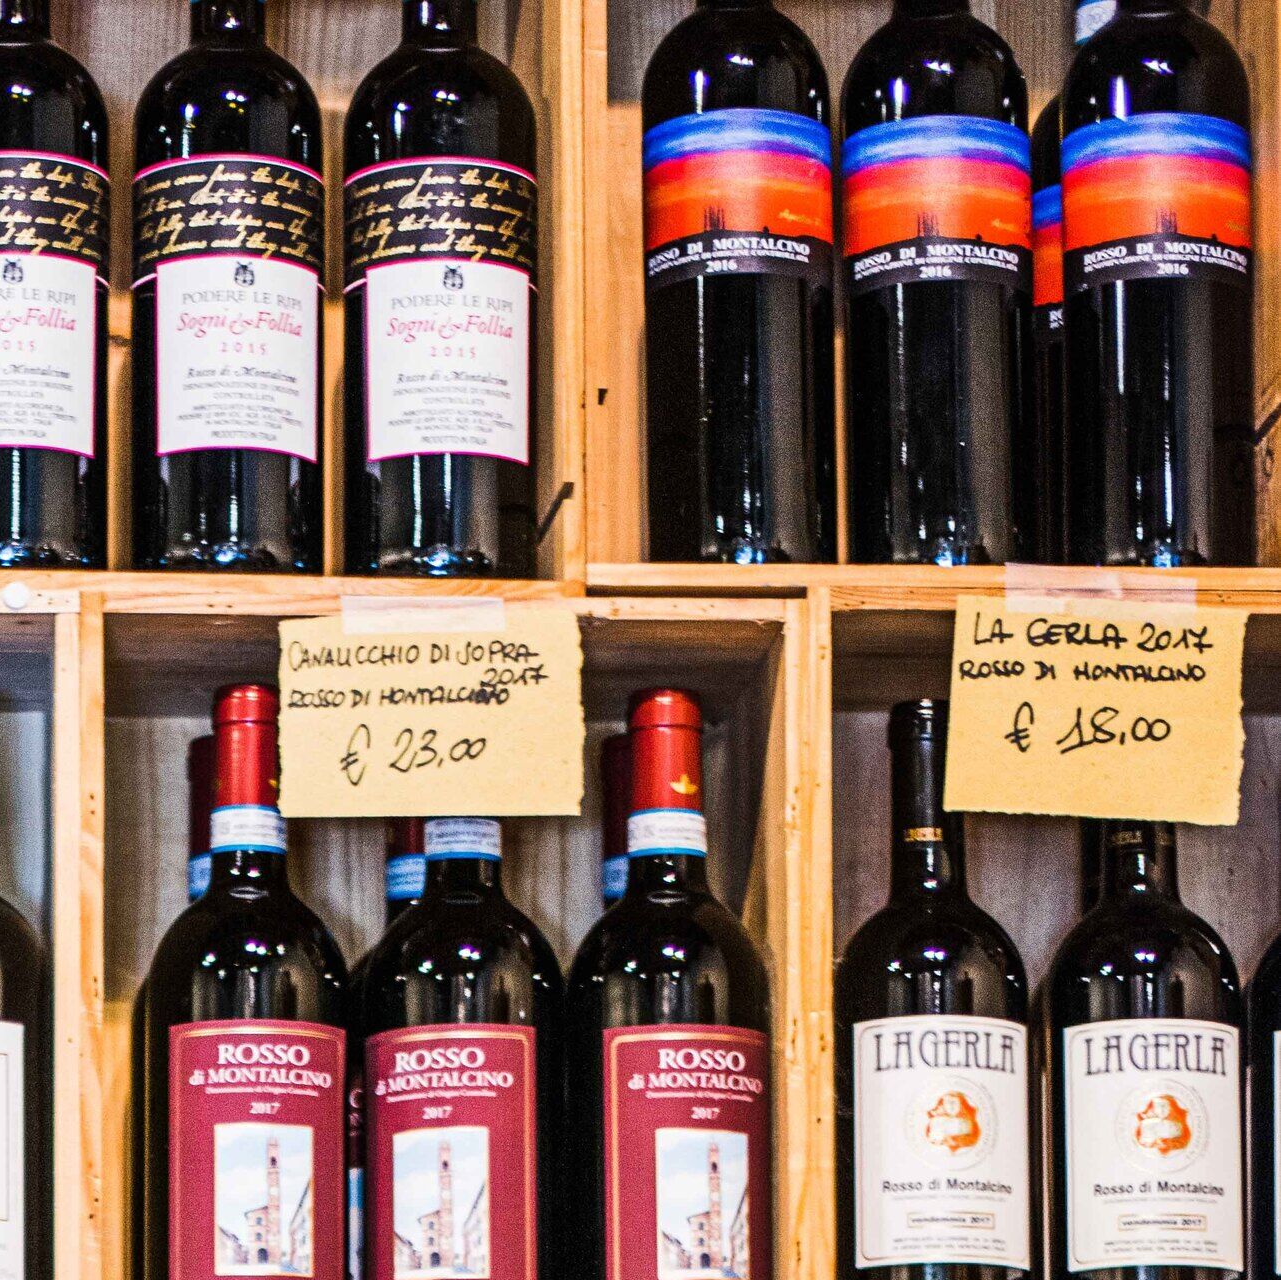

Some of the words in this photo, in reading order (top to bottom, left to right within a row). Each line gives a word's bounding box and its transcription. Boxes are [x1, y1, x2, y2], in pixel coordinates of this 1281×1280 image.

[900, 247, 916, 260] DI
[926, 244, 1019, 264] MONTALCINO
[919, 266, 952, 278] 2016
[23, 288, 40, 300] LE
[48, 289, 76, 306] RIPI
[974, 611, 1014, 646] LA
[1026, 617, 1128, 649] GERLA
[1137, 622, 1214, 654] 2017
[430, 643, 450, 664] DI
[456, 640, 541, 666] SOPRA
[480, 663, 549, 688] 2017
[959, 659, 1025, 681] ROSSO
[1034, 660, 1056, 681] DI
[1073, 661, 1206, 683] MONTALCINO
[217, 1043, 310, 1066] ROSSO
[874, 1031, 913, 1073] LA
[918, 1029, 1016, 1075] GERLA
[188, 1069, 205, 1085] di
[208, 1067, 332, 1088] MONTALCINO
[249, 1102, 281, 1115] 2017
[882, 1179, 923, 1195] Rosso
[928, 1180, 941, 1193] di
[946, 1178, 1012, 1195] Montalcino
